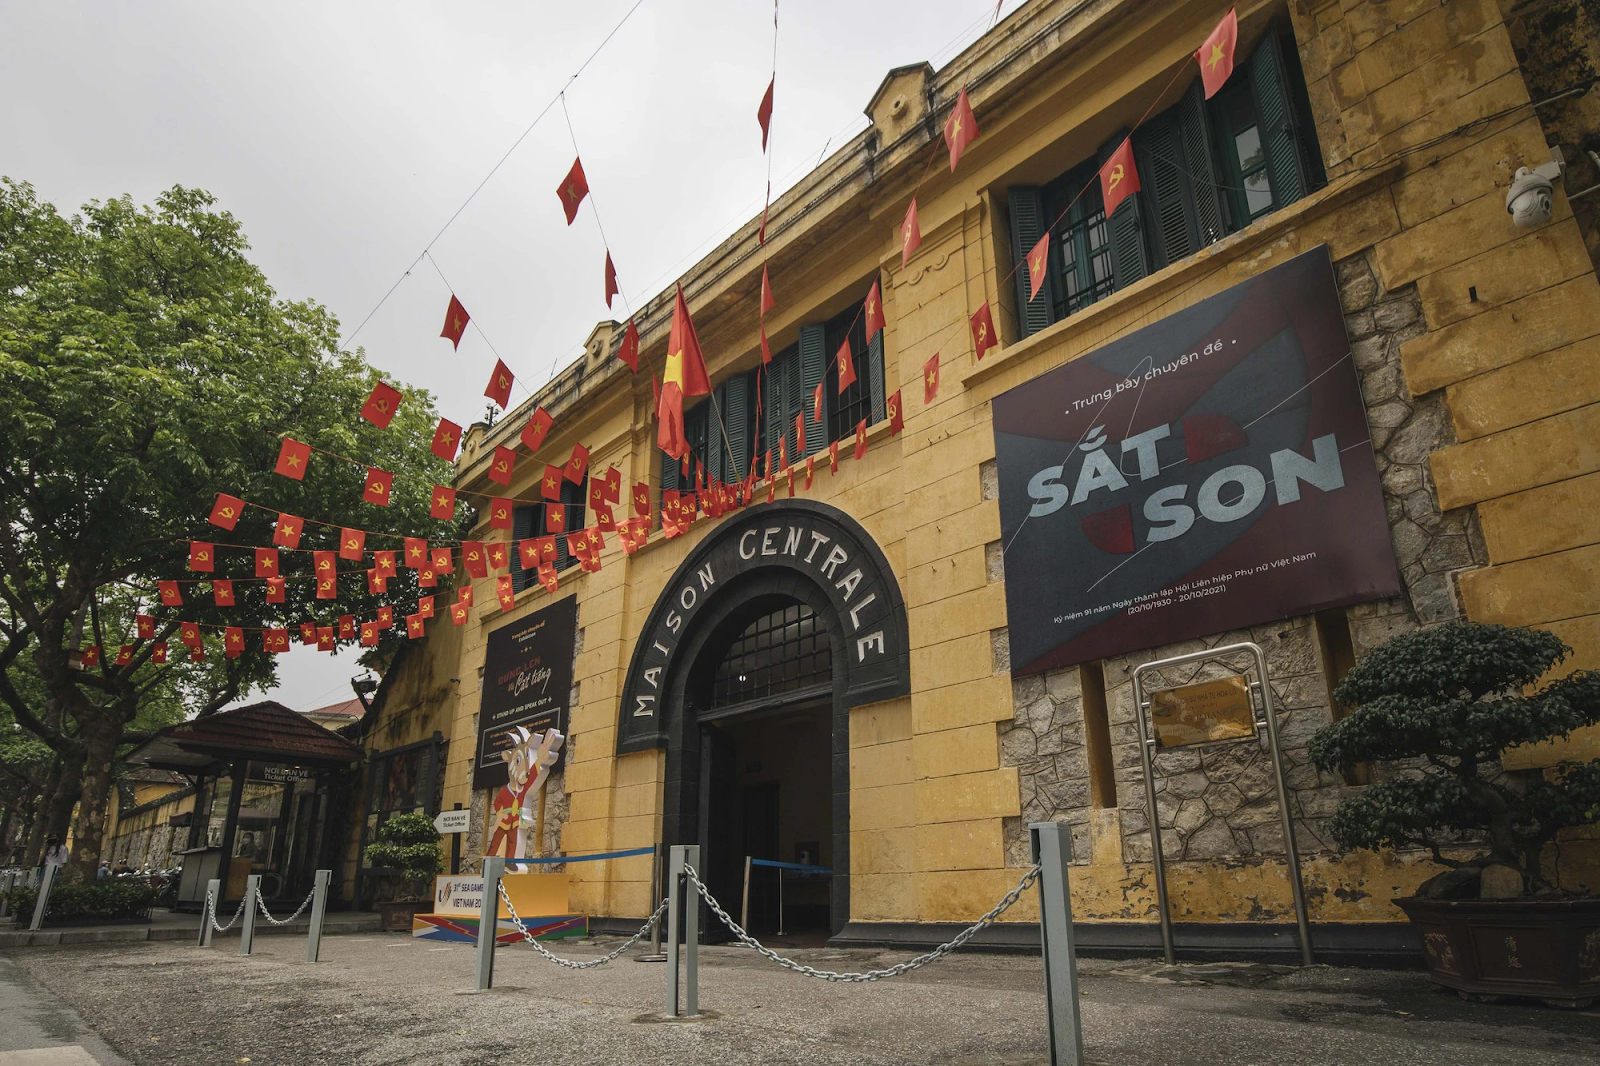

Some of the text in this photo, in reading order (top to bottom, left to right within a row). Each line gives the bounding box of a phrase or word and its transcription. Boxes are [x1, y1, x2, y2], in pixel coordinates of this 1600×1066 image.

[1072, 339, 1223, 411] Trưng bày chuyên đề
[1027, 423, 1171, 518] SẮT
[1143, 433, 1345, 542] SON
[1064, 611, 1083, 621] niệm
[1084, 608, 1092, 616] 91
[1093, 605, 1111, 614] năm
[1112, 599, 1133, 609] Ngày
[1134, 592, 1159, 603] thành
[1160, 588, 1173, 597] lập
[1175, 583, 1190, 592] Hội
[1192, 580, 1211, 590] Liên
[1212, 573, 1233, 584] hiệp
[1234, 568, 1254, 578] Phụ
[1256, 563, 1269, 573] nữ
[1270, 558, 1291, 569] Việt
[1292, 551, 1317, 563] Nam
[1127, 598, 1172, 616] (20/10/1930
[1179, 584, 1226, 603] 20/10/2021)
[633, 526, 885, 717] MAISON CENTRALE
[496, 710, 509, 719] STAND
[515, 705, 524, 714] AND
[524, 700, 537, 709] SPEAK
[538, 698, 548, 706] OUT
[264, 773, 308, 783] Ticket Office
[461, 884, 470, 892] SEA
[470, 883, 484, 892] GAME
[463, 898, 474, 908] NAM
[474, 898, 482, 908] 20
